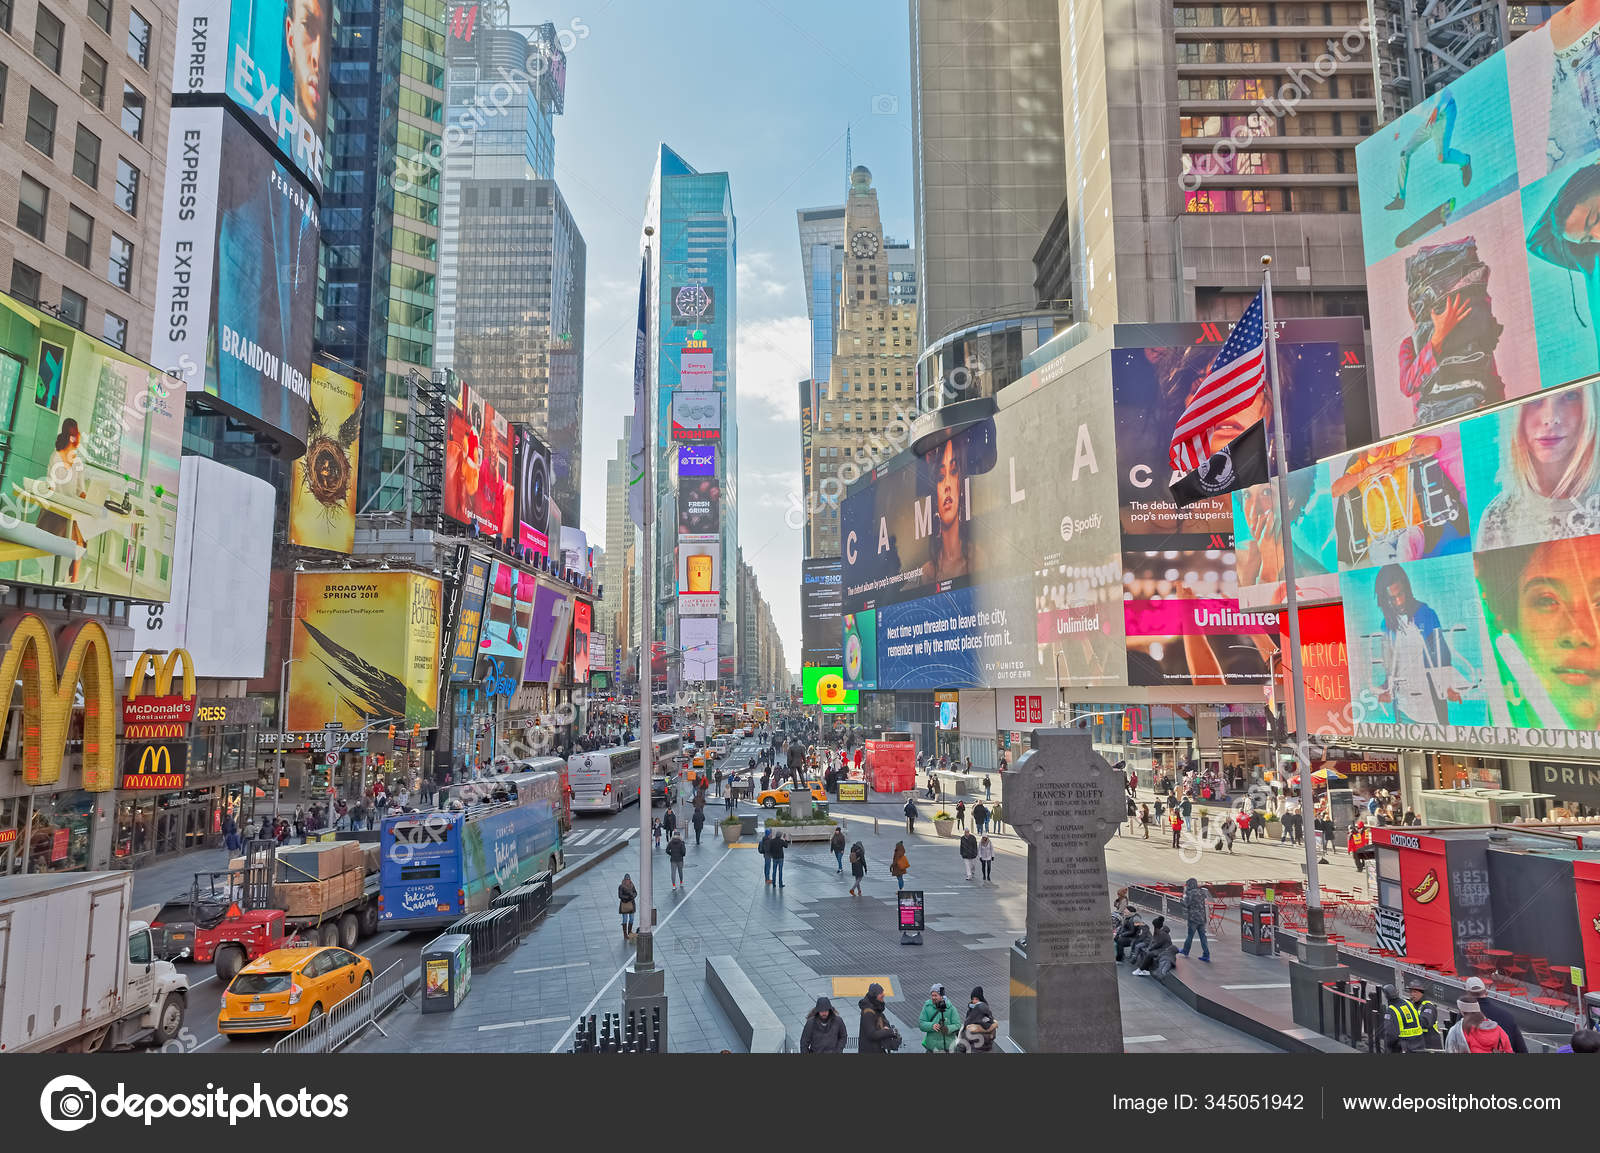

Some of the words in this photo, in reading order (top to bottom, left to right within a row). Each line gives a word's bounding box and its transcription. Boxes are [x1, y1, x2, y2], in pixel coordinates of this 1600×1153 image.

[178, 130, 200, 221] EXPRESS
[168, 240, 193, 343] EXPRESS
[222, 325, 279, 381] BRANDON
[673, 430, 720, 439] TOSHIBA
[688, 456, 712, 465] TDK
[1130, 501, 1149, 510] The
[1212, 500, 1224, 512] by
[1074, 513, 1102, 535] Spotify
[1131, 512, 1156, 522] pop's
[1158, 512, 1193, 520] newest
[888, 626, 899, 639] Next
[913, 625, 923, 638] you
[924, 620, 949, 634] threaten
[950, 618, 957, 630] to
[958, 614, 976, 630] leave
[978, 611, 990, 626] the
[1057, 614, 1099, 634] Unlimited
[888, 644, 914, 657] remember
[914, 644, 923, 655] we
[933, 639, 942, 652] the
[944, 636, 960, 651] most
[961, 634, 982, 652] places
[983, 631, 1001, 648] from
[1306, 674, 1345, 701] EAGLE
[126, 702, 191, 714] McDonald's
[255, 733, 295, 743] GIFTS
[305, 733, 366, 742] LUGAGE
[1355, 723, 1448, 745] AMERICAN
[1455, 726, 1520, 746] EAGLE
[1076, 790, 1103, 798] DUFFY
[1390, 833, 1420, 848] HOTDOGS
[404, 892, 425, 905] take
[413, 898, 438, 910] away
